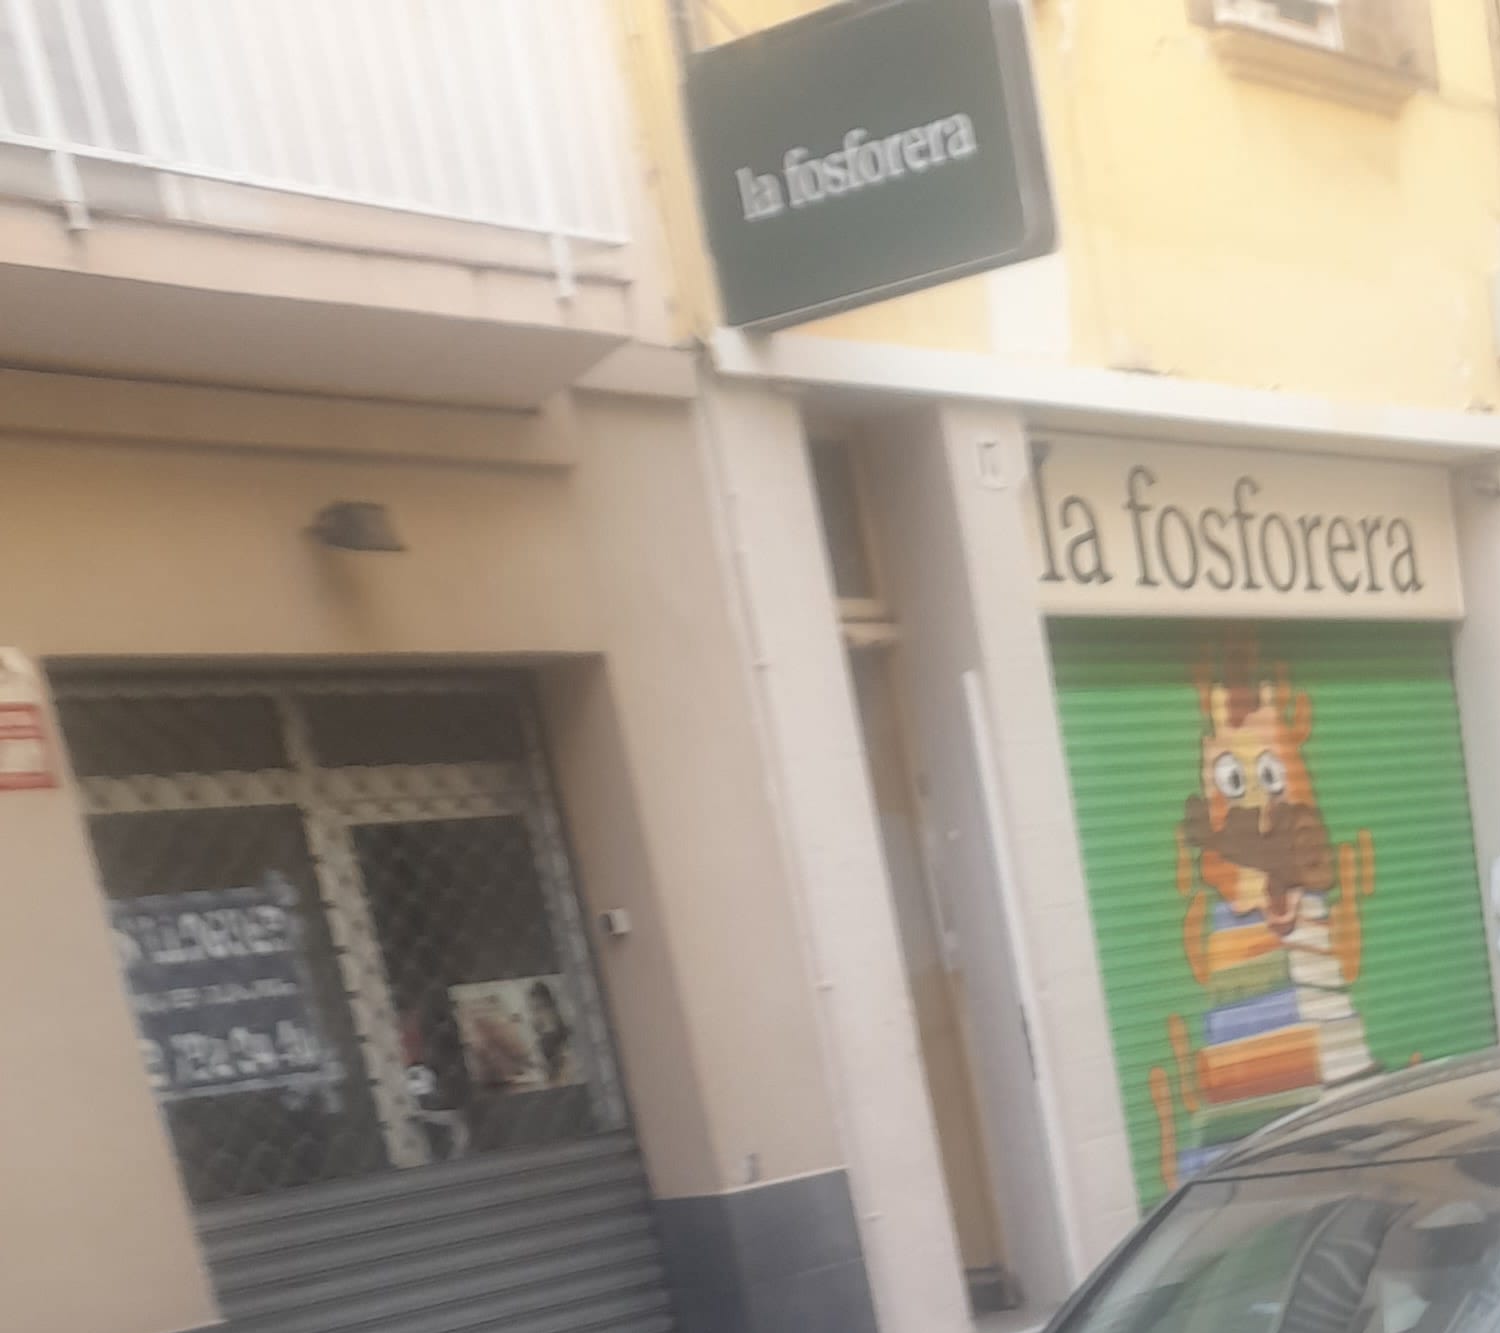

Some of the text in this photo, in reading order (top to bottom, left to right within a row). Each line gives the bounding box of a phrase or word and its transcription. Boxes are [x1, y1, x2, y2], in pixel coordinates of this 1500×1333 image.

[735, 112, 978, 222] la fosforera
[1030, 440, 1425, 593] la fosforera
